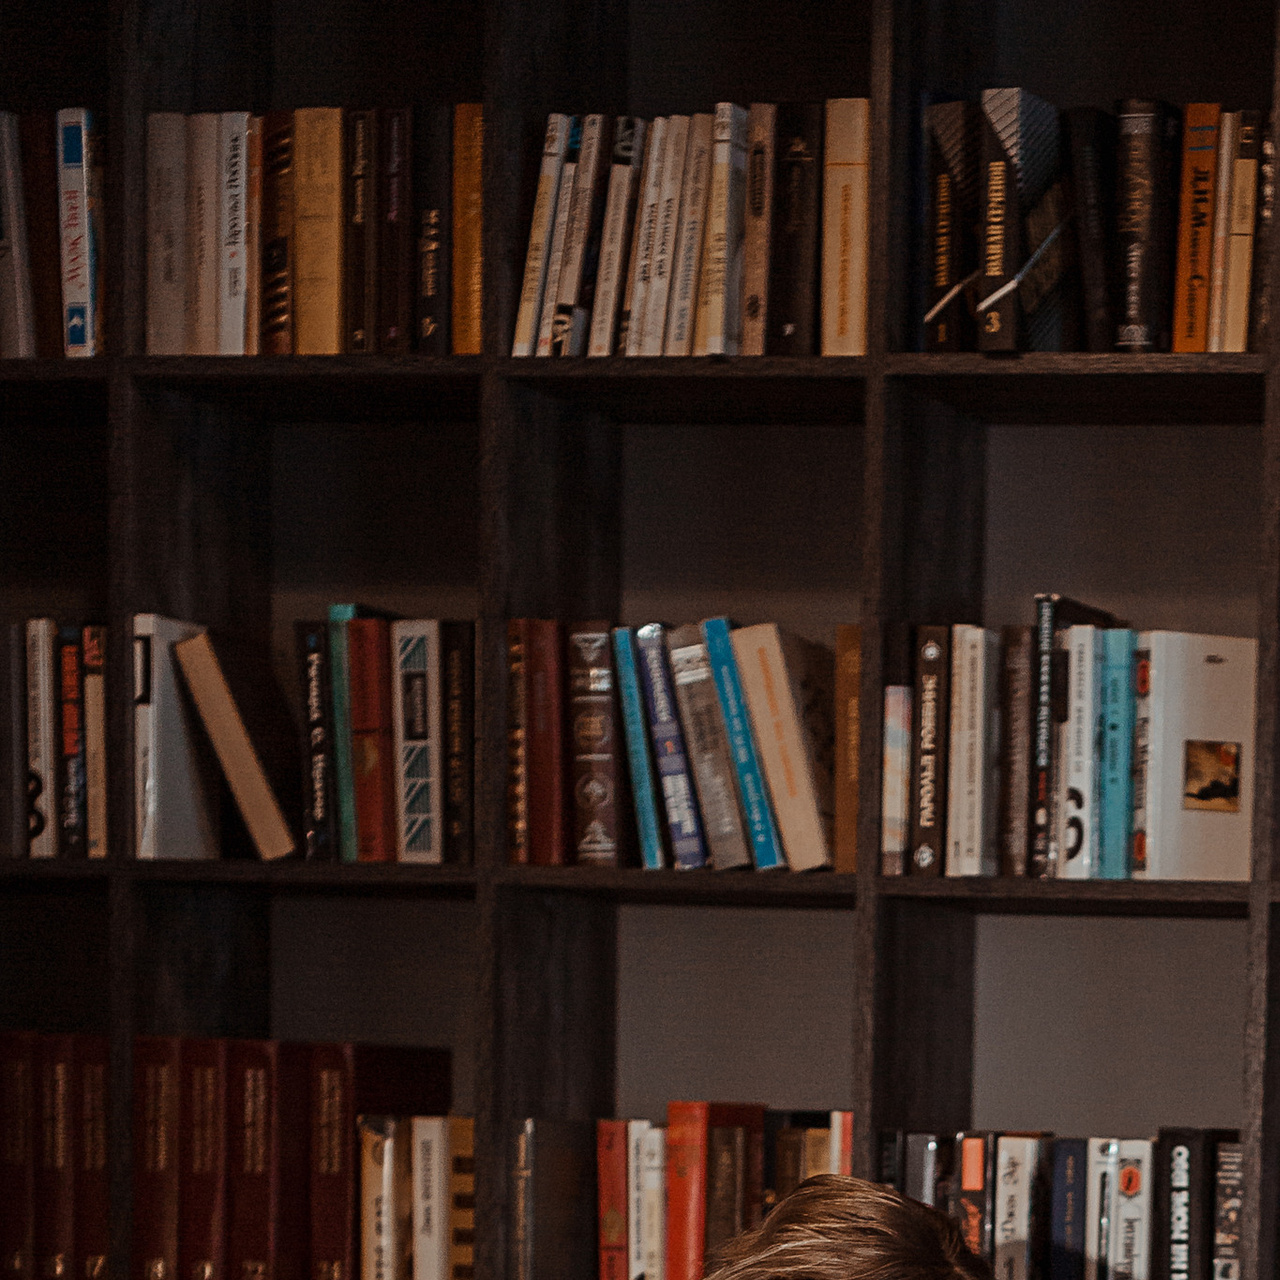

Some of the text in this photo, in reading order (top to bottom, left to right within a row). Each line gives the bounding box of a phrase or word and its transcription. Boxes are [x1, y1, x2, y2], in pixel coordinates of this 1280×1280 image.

[984, 311, 1001, 333] 3
[918, 753, 936, 828] ГАРОЛЬД
[1170, 1189, 1188, 1240] МОРЕ
